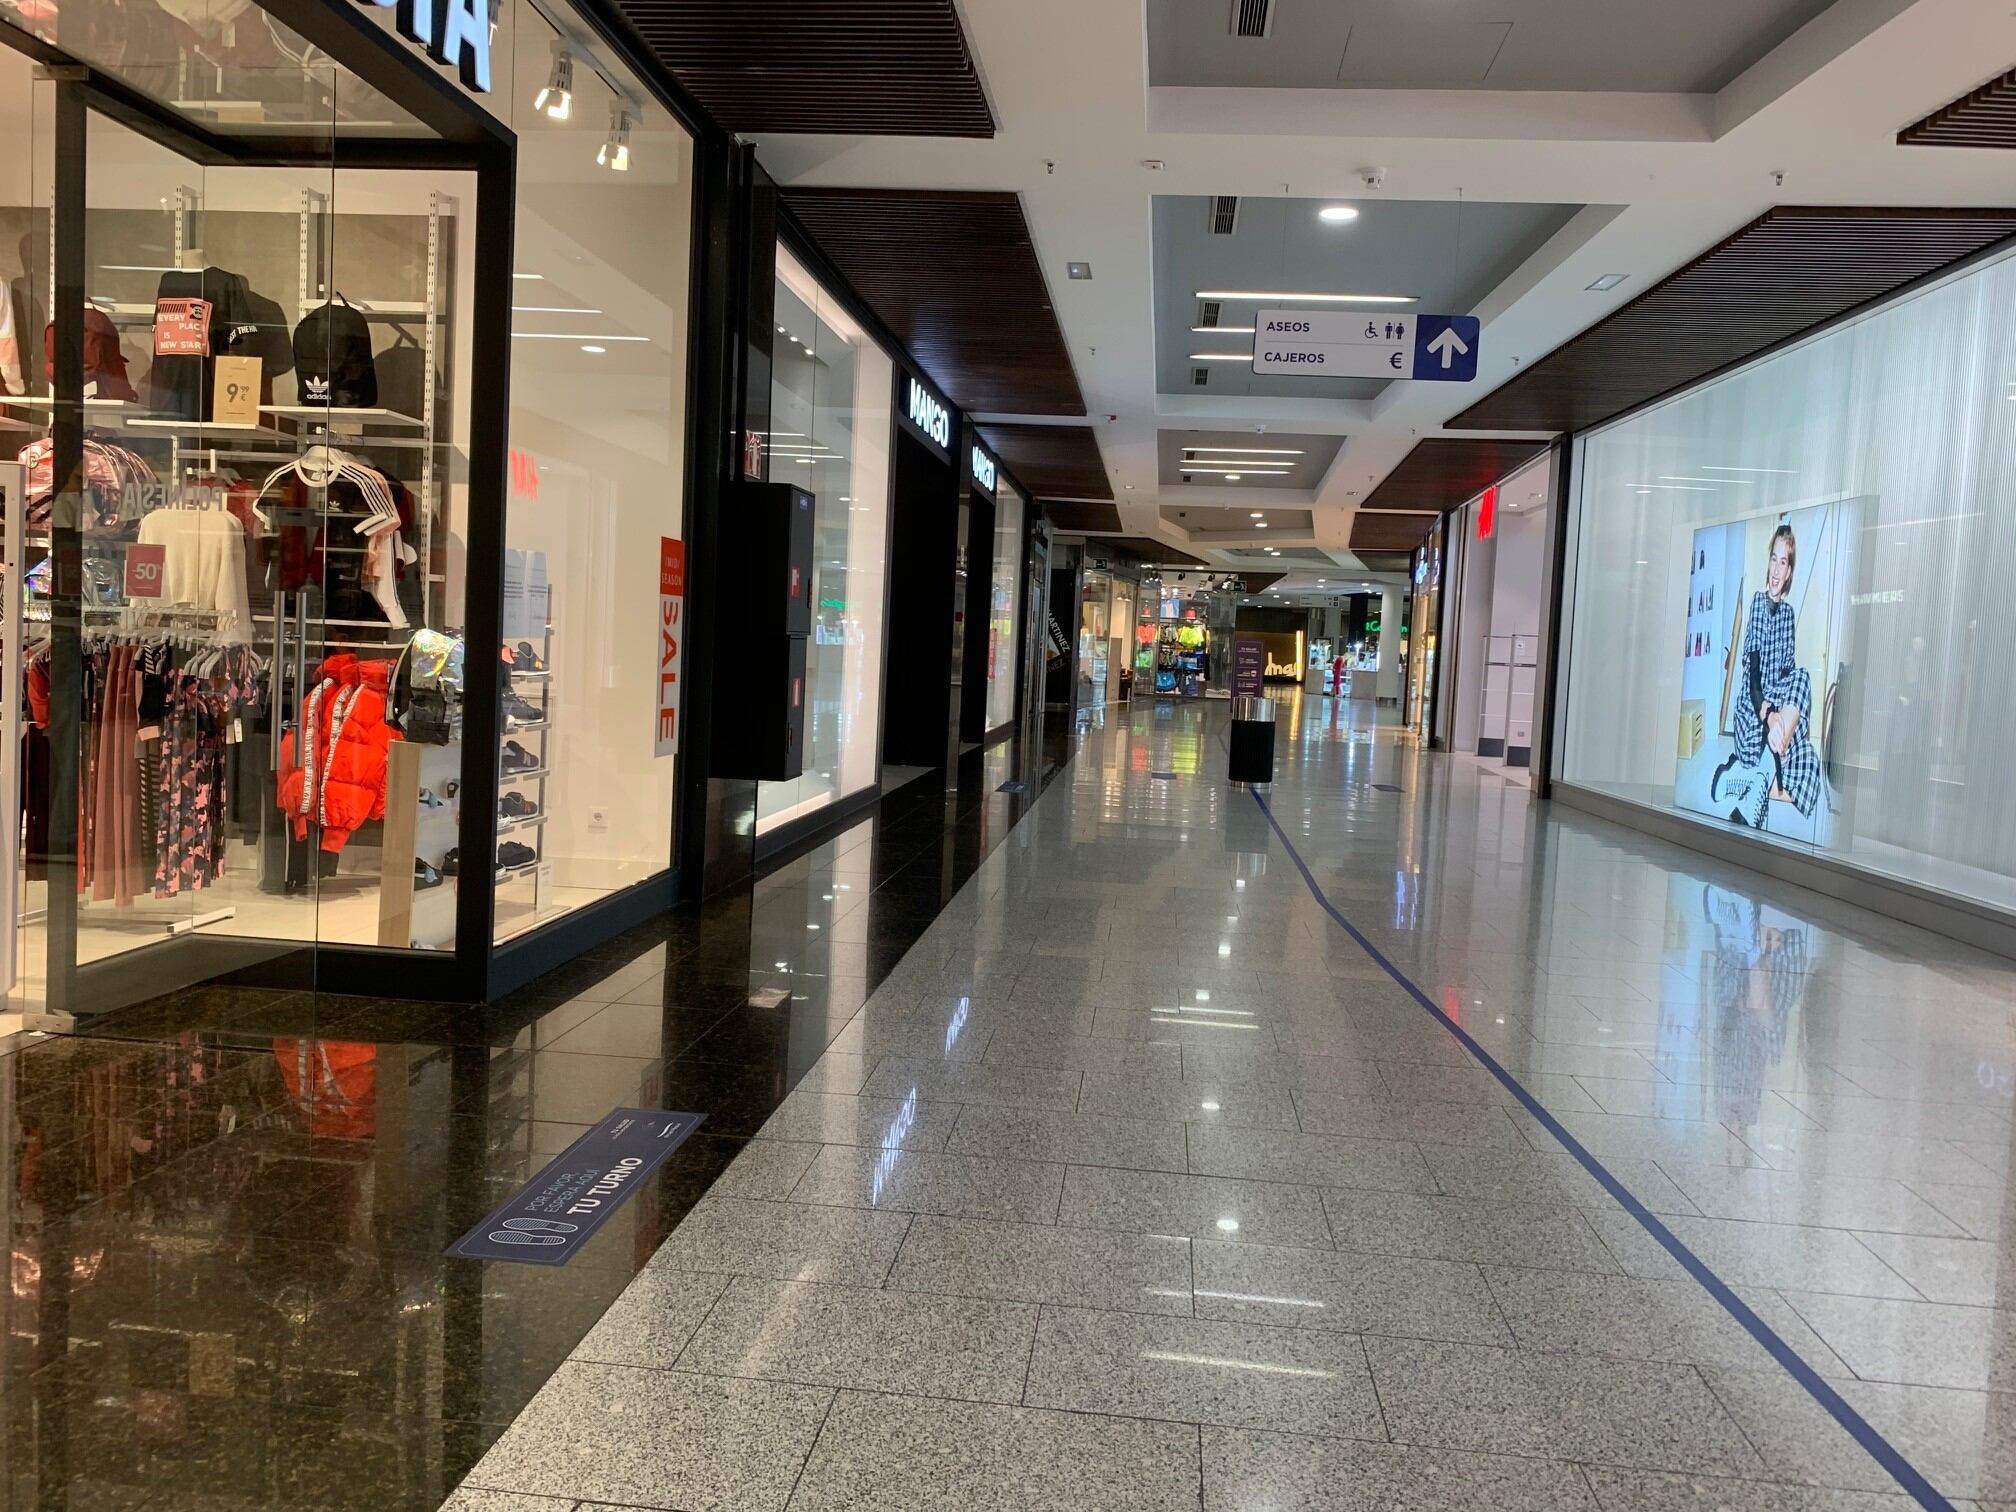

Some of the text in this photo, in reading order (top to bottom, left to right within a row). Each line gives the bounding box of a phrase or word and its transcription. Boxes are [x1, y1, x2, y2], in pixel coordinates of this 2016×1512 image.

[157, 313, 186, 322] EVERY
[1266, 321, 1310, 332] ASEOS
[160, 341, 177, 350] NEW
[1264, 352, 1403, 369] CAJEROS €
[306, 393, 332, 401] adidas
[909, 377, 949, 448] MANGO
[972, 446, 995, 492] MANGO
[661, 572, 682, 586] SEASON
[660, 600, 679, 743] SALE
[566, 1157, 643, 1215] TU TURNO
[524, 1195, 549, 1212] POR
[544, 1186, 580, 1213] ESPERA
